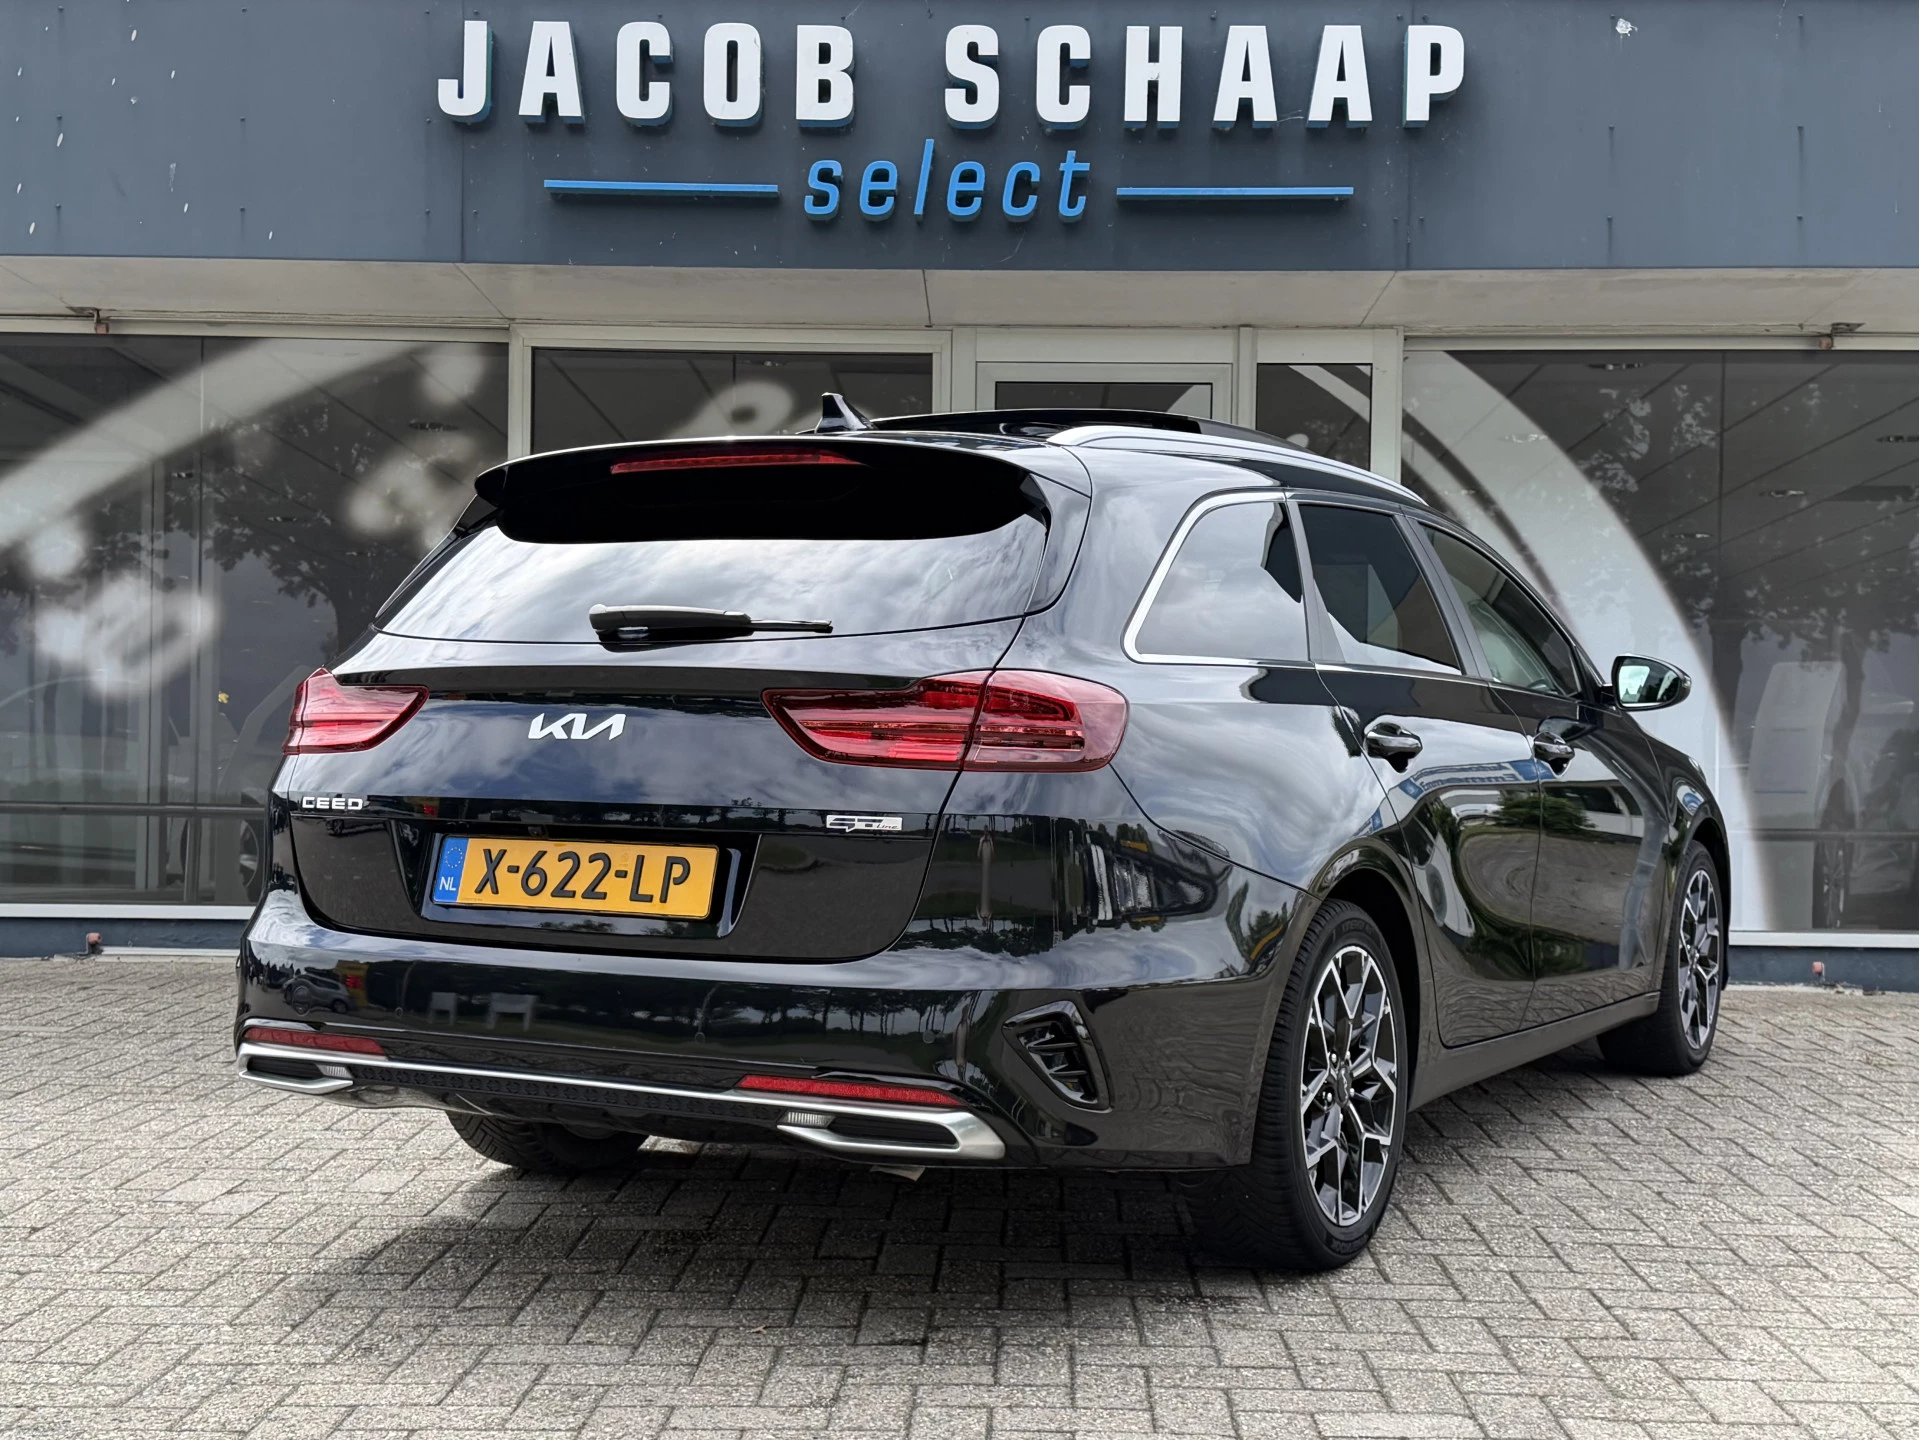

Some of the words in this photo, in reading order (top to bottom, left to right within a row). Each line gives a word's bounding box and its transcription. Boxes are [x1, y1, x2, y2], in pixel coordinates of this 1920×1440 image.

[437, 20, 854, 124] JACOB
[944, 24, 1465, 126] SCHAAP
[803, 138, 1091, 221] select
[528, 712, 627, 741] KIA
[302, 796, 363, 811] CEED
[438, 876, 457, 892] NL
[474, 848, 691, 904] X-622-LP
